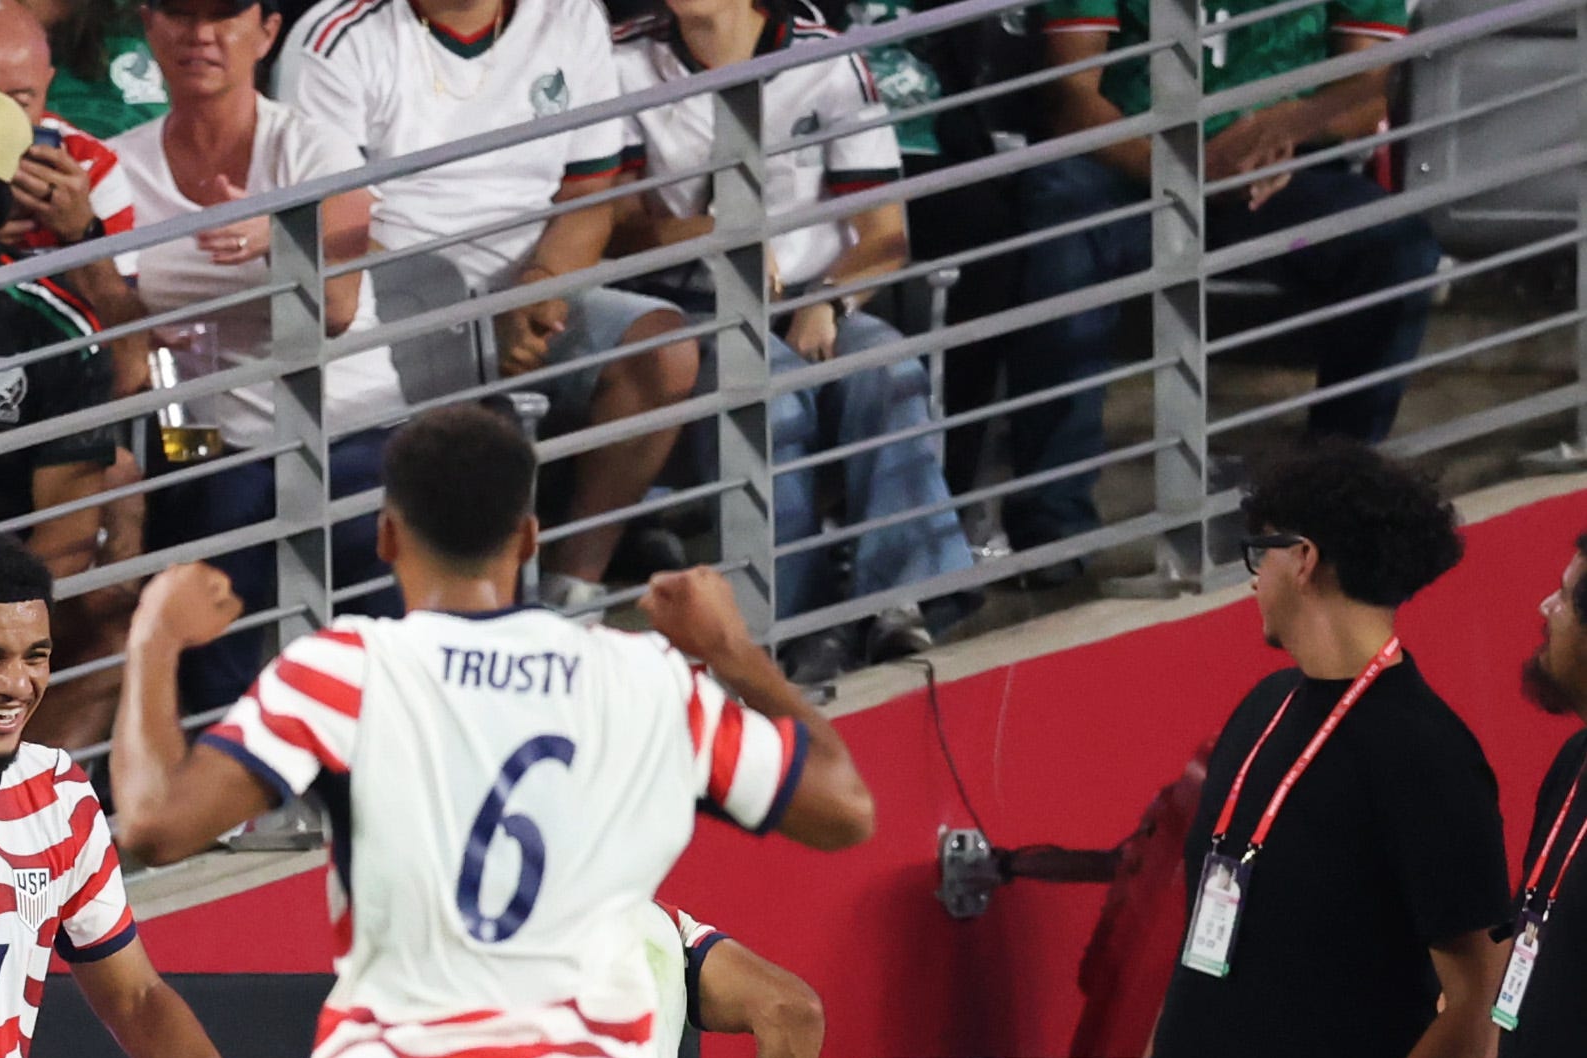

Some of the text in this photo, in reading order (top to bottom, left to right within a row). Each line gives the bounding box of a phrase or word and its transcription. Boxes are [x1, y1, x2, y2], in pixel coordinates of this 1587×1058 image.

[439, 645, 581, 694] TRUSTY
[455, 733, 577, 943] 6
[16, 872, 48, 896] USA
